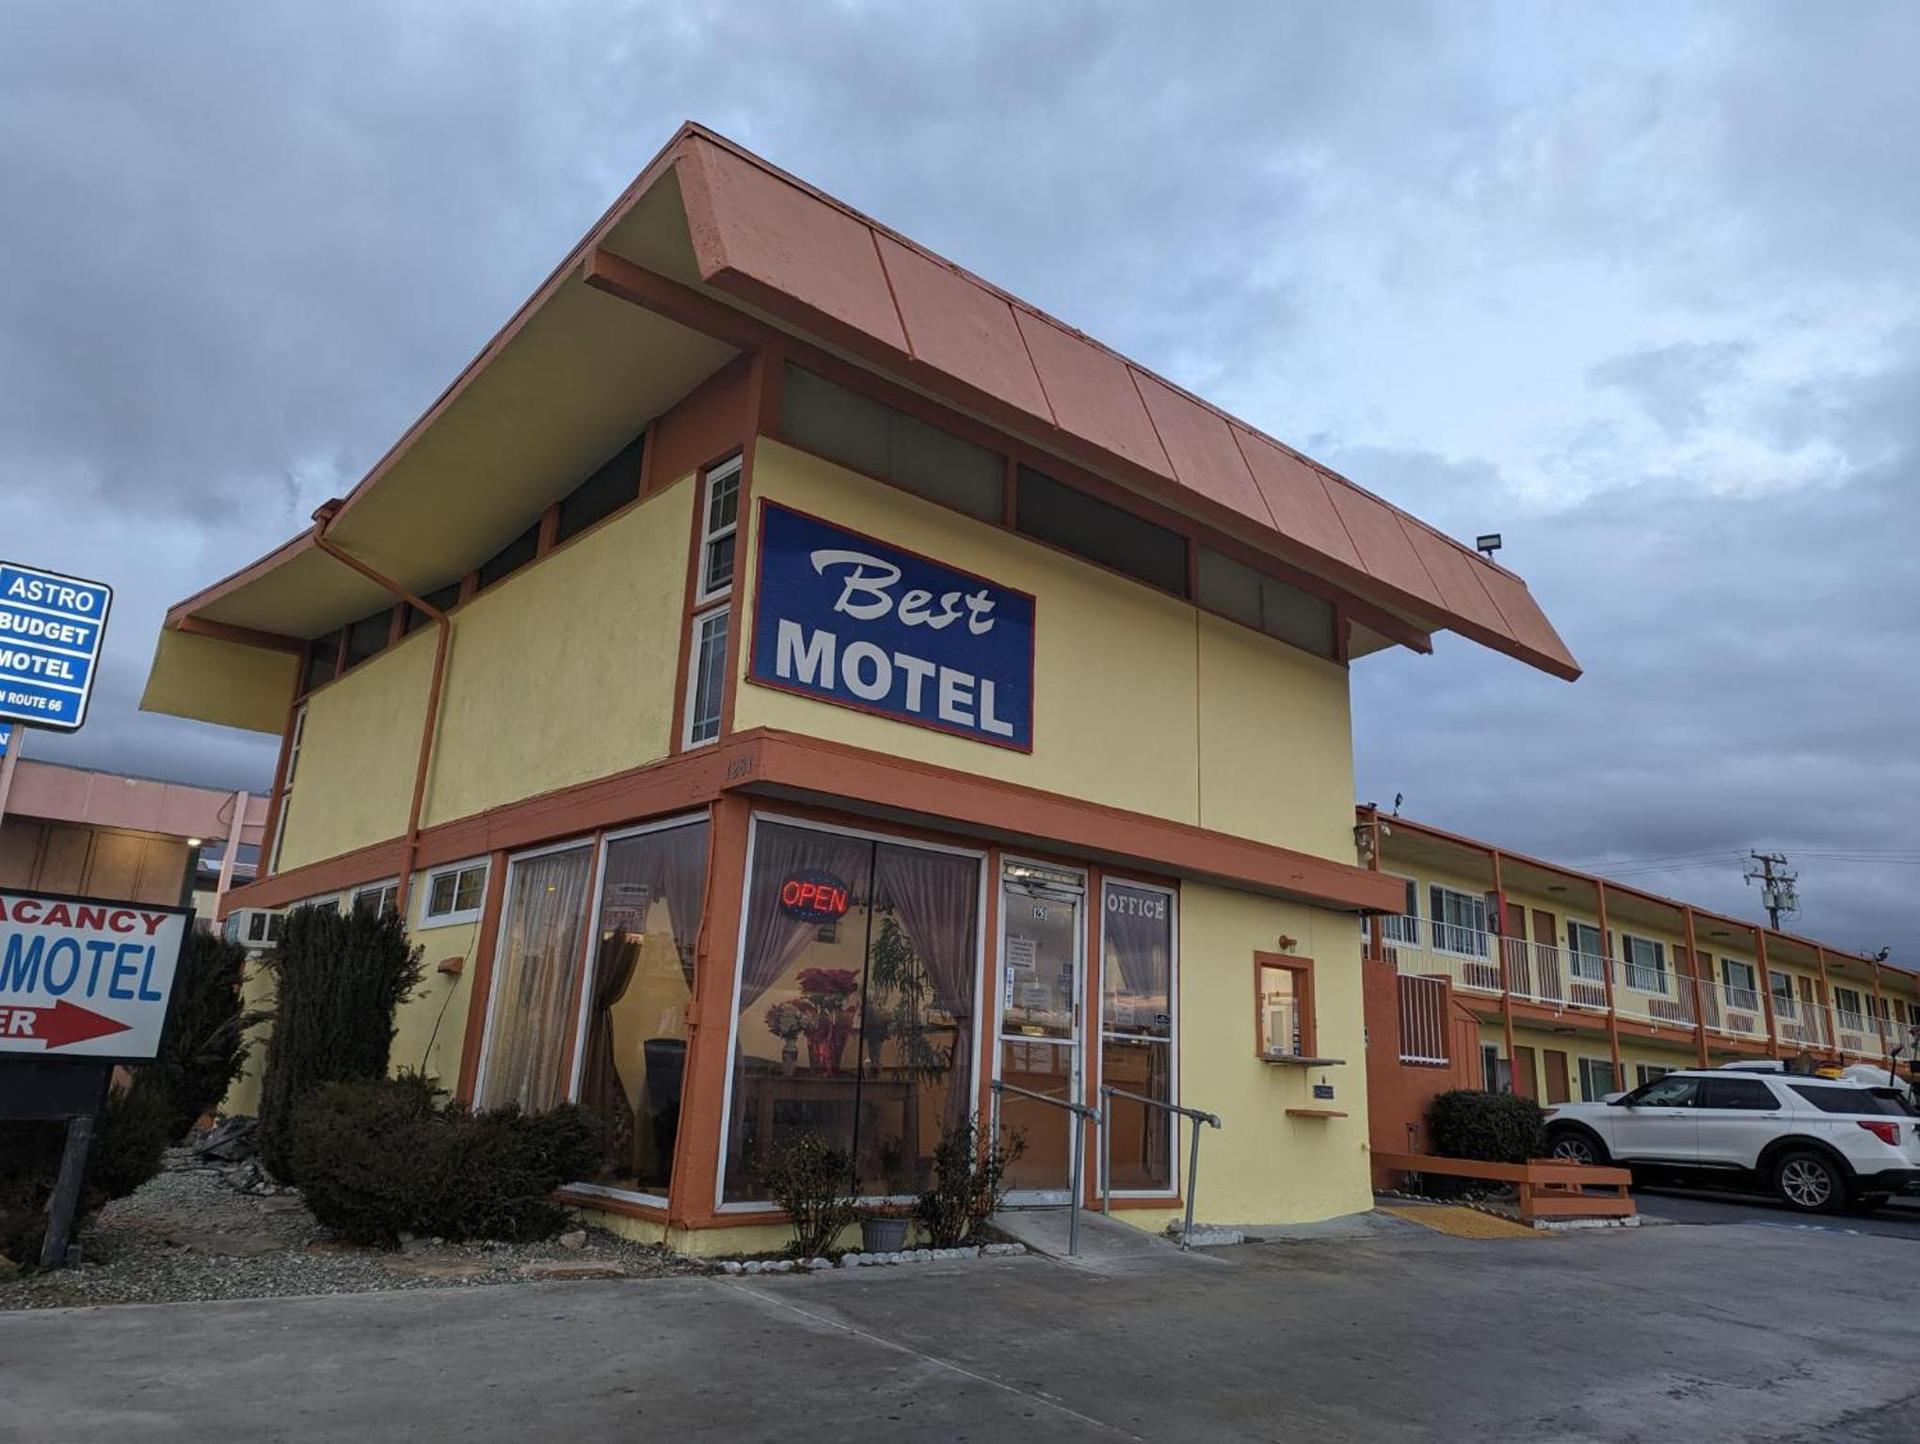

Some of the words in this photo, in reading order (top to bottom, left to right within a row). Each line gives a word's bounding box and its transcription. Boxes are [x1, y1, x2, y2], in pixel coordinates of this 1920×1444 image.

[8, 577, 94, 612] ASTRO
[810, 549, 996, 635] Best
[0, 611, 90, 645] BUDGET
[776, 618, 1014, 738] MOTEL
[8, 692, 47, 709] ROUTE
[48, 699, 62, 712] 66
[783, 880, 848, 912] OPEN
[1107, 893, 1166, 920] OFFICE
[0, 933, 162, 1001] MOTEL
